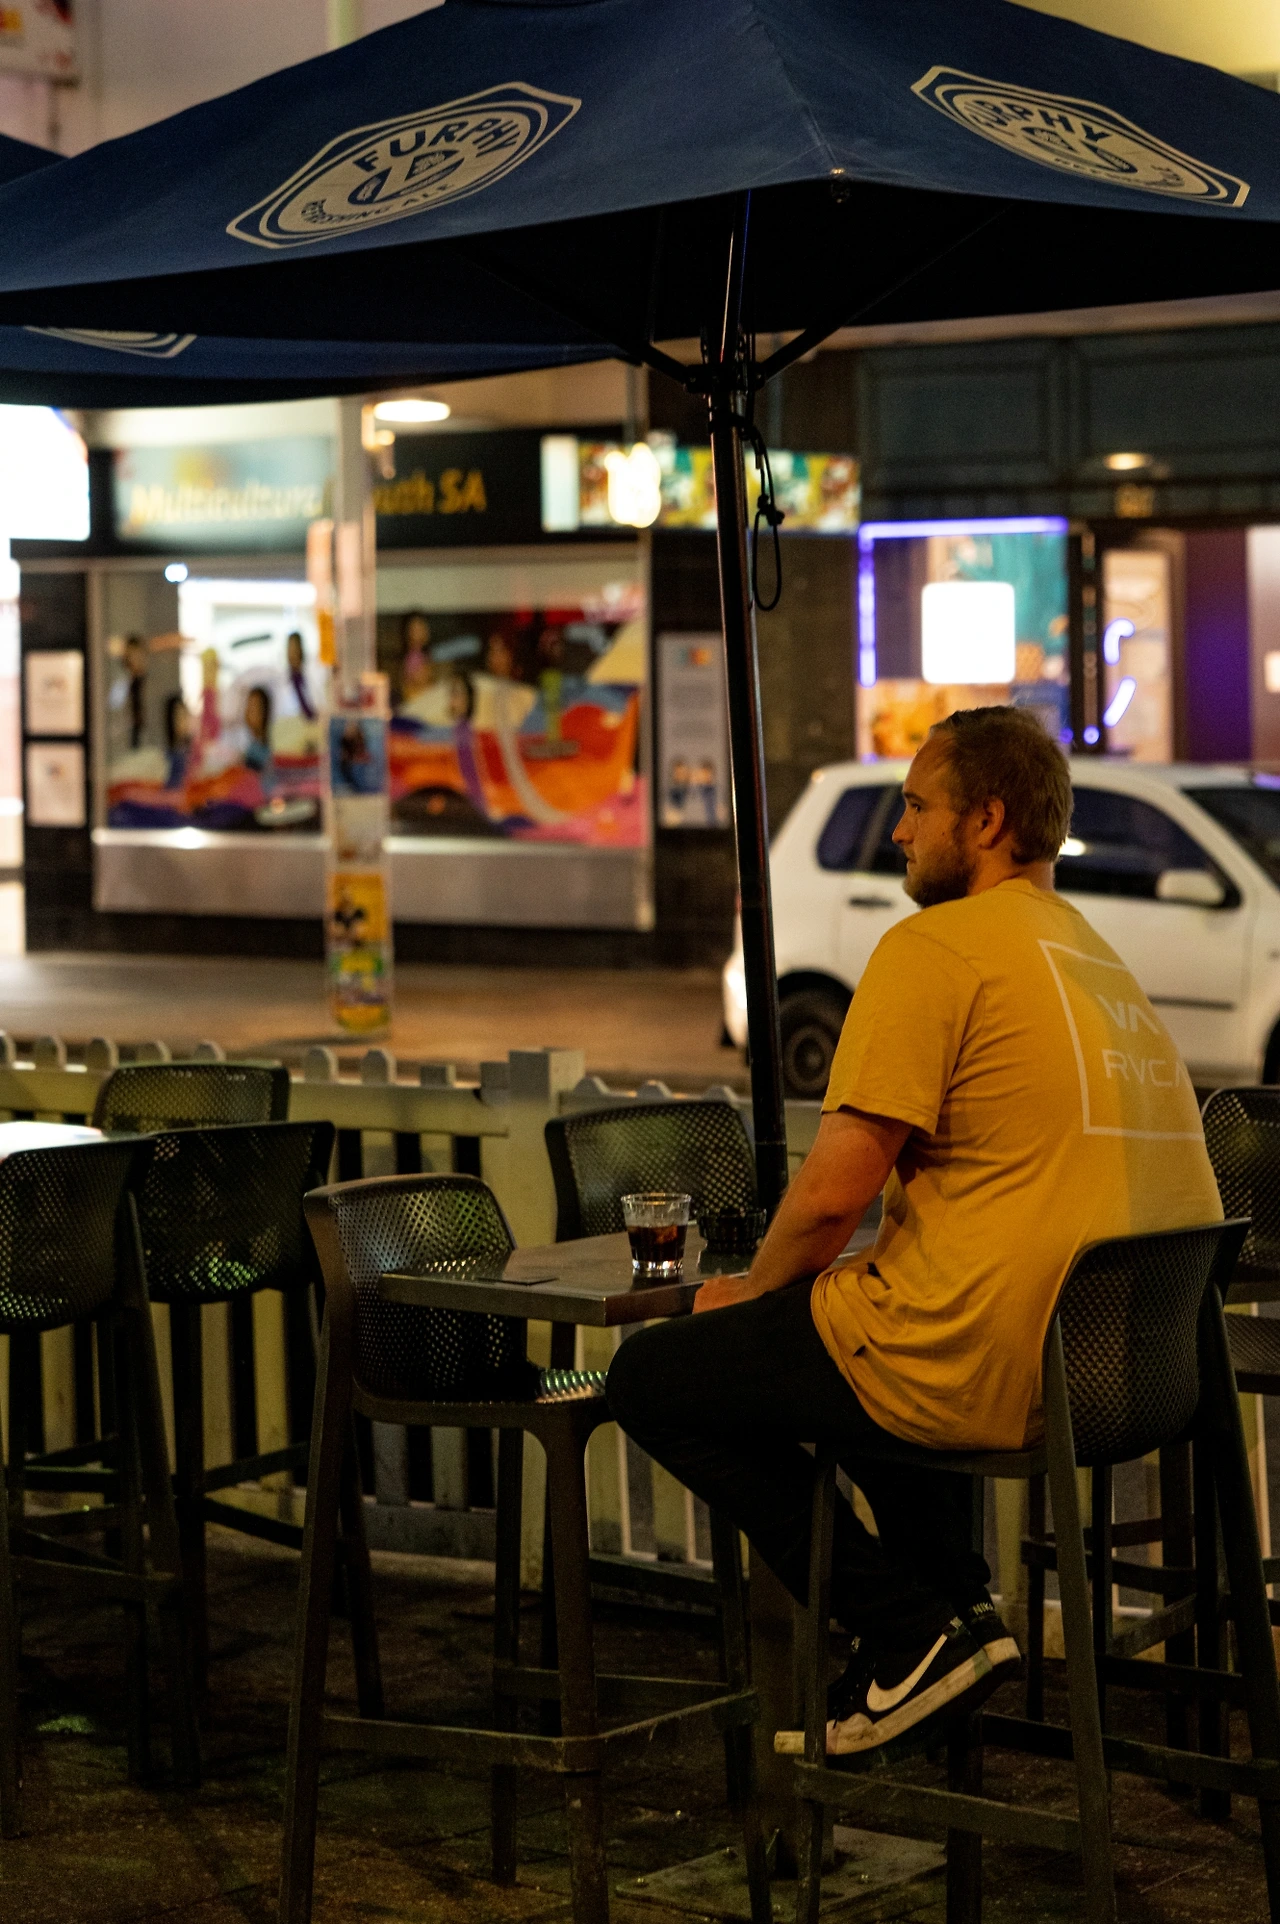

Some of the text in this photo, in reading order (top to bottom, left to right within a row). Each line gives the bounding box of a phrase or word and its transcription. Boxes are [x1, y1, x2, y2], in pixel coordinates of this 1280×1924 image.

[964, 100, 1113, 138] FURPHY
[352, 117, 521, 173] FURPHY
[439, 468, 487, 514] SA
[1101, 1048, 1194, 1089] RVCA
